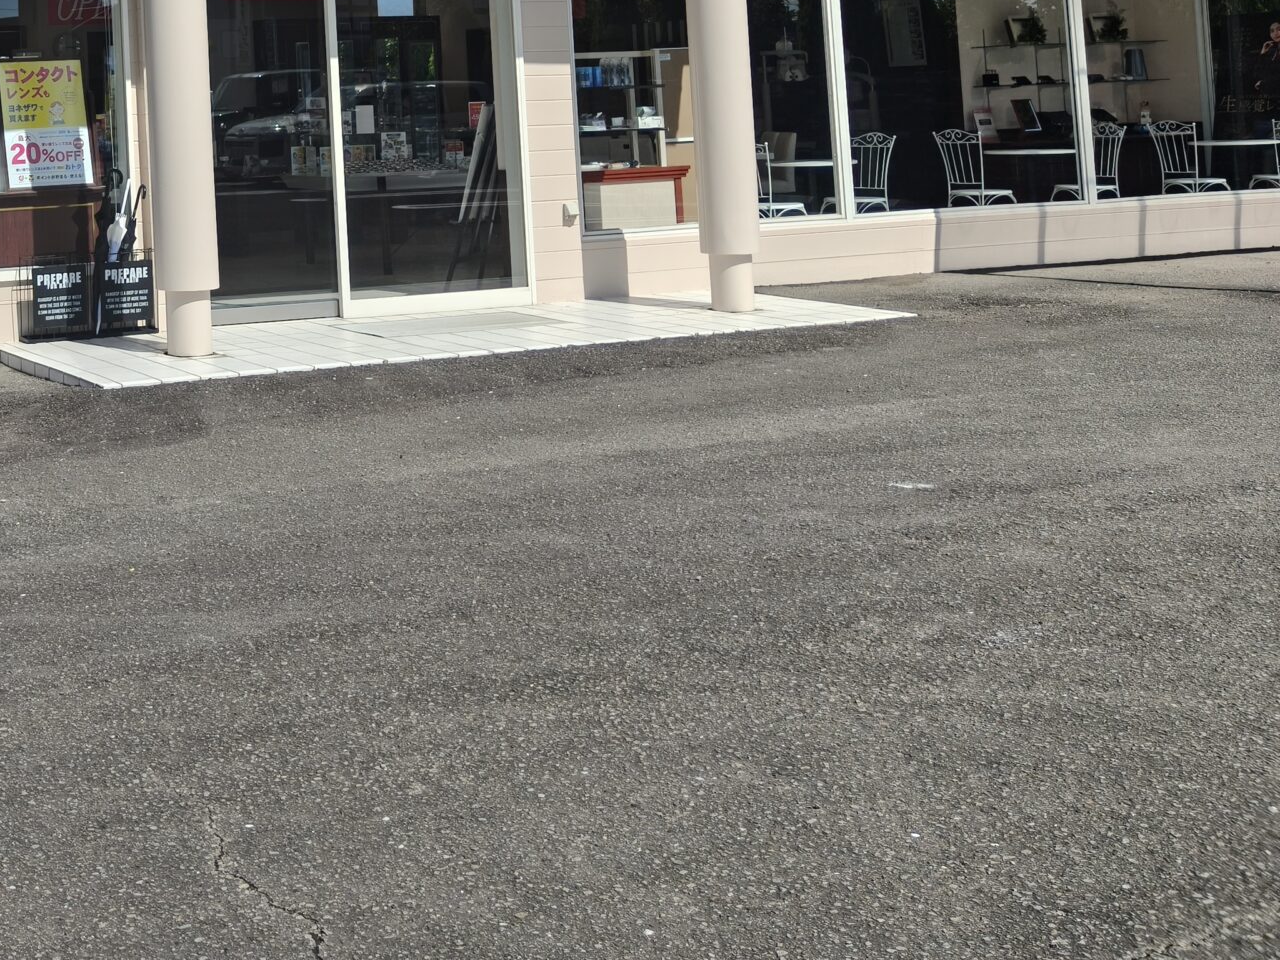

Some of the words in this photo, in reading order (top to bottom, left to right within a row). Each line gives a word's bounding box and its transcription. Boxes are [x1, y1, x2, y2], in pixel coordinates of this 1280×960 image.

[4, 65, 78, 84] コンタクト
[37, 272, 82, 286] PREPARE
[105, 267, 148, 280] PREPARE
